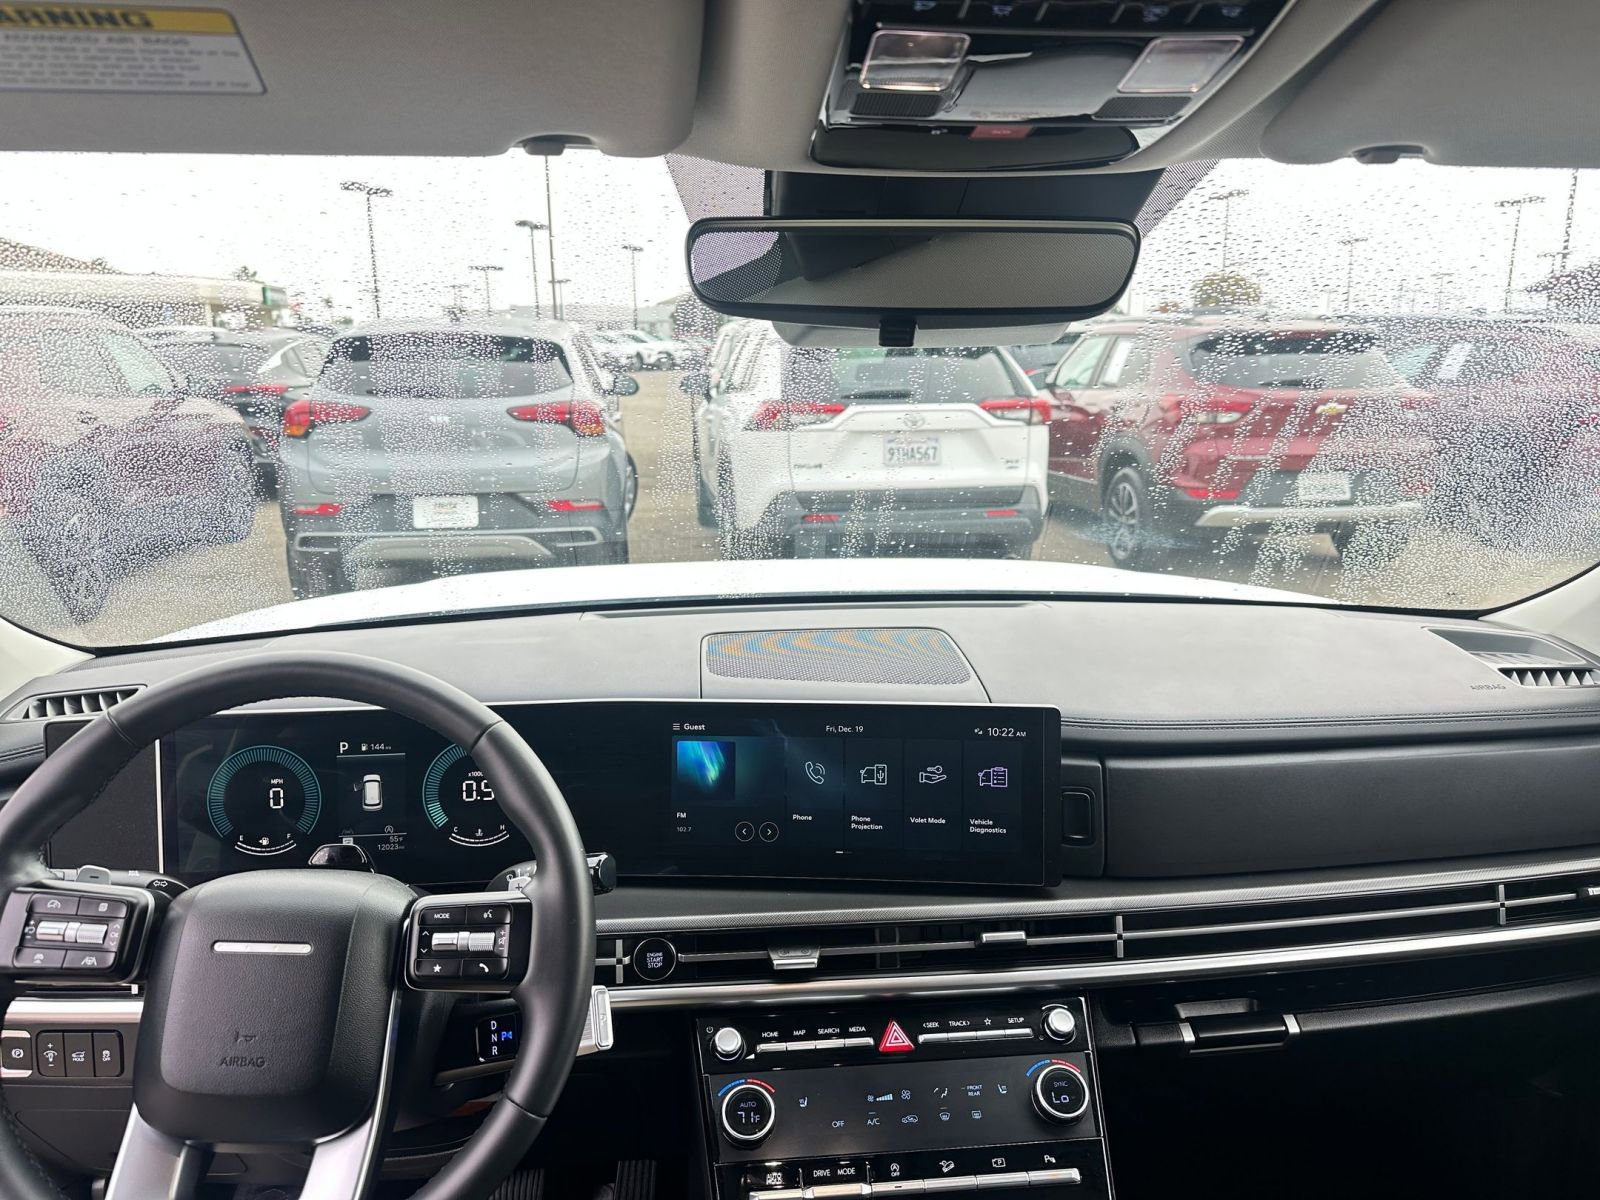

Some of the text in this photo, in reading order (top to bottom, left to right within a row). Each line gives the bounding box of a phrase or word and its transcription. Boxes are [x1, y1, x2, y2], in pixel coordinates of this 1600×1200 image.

[683, 723, 706, 731] Guest
[825, 725, 864, 733] Fri, Dec. 19
[987, 727, 1015, 737] 10:22
[340, 741, 349, 754] P
[462, 779, 495, 801] 0.5
[269, 787, 284, 809] 0
[910, 816, 927, 824] Valet
[969, 818, 993, 826] Vehicle
[851, 823, 883, 831] Projection
[969, 826, 1007, 834] Diagnostics
[378, 843, 399, 851] 12023
[490, 1020, 497, 1030] D
[817, 1027, 840, 1035] SEARCH
[491, 1032, 498, 1043] N
[492, 1045, 498, 1056] R
[219, 1055, 267, 1068] AIRBAG
[1053, 1080, 1069, 1088] SYNC
[739, 1101, 757, 1109] AUTO
[831, 1120, 845, 1128] OFF
[866, 1117, 881, 1126] A/C
[813, 1167, 856, 1178] DRIVE MODE
